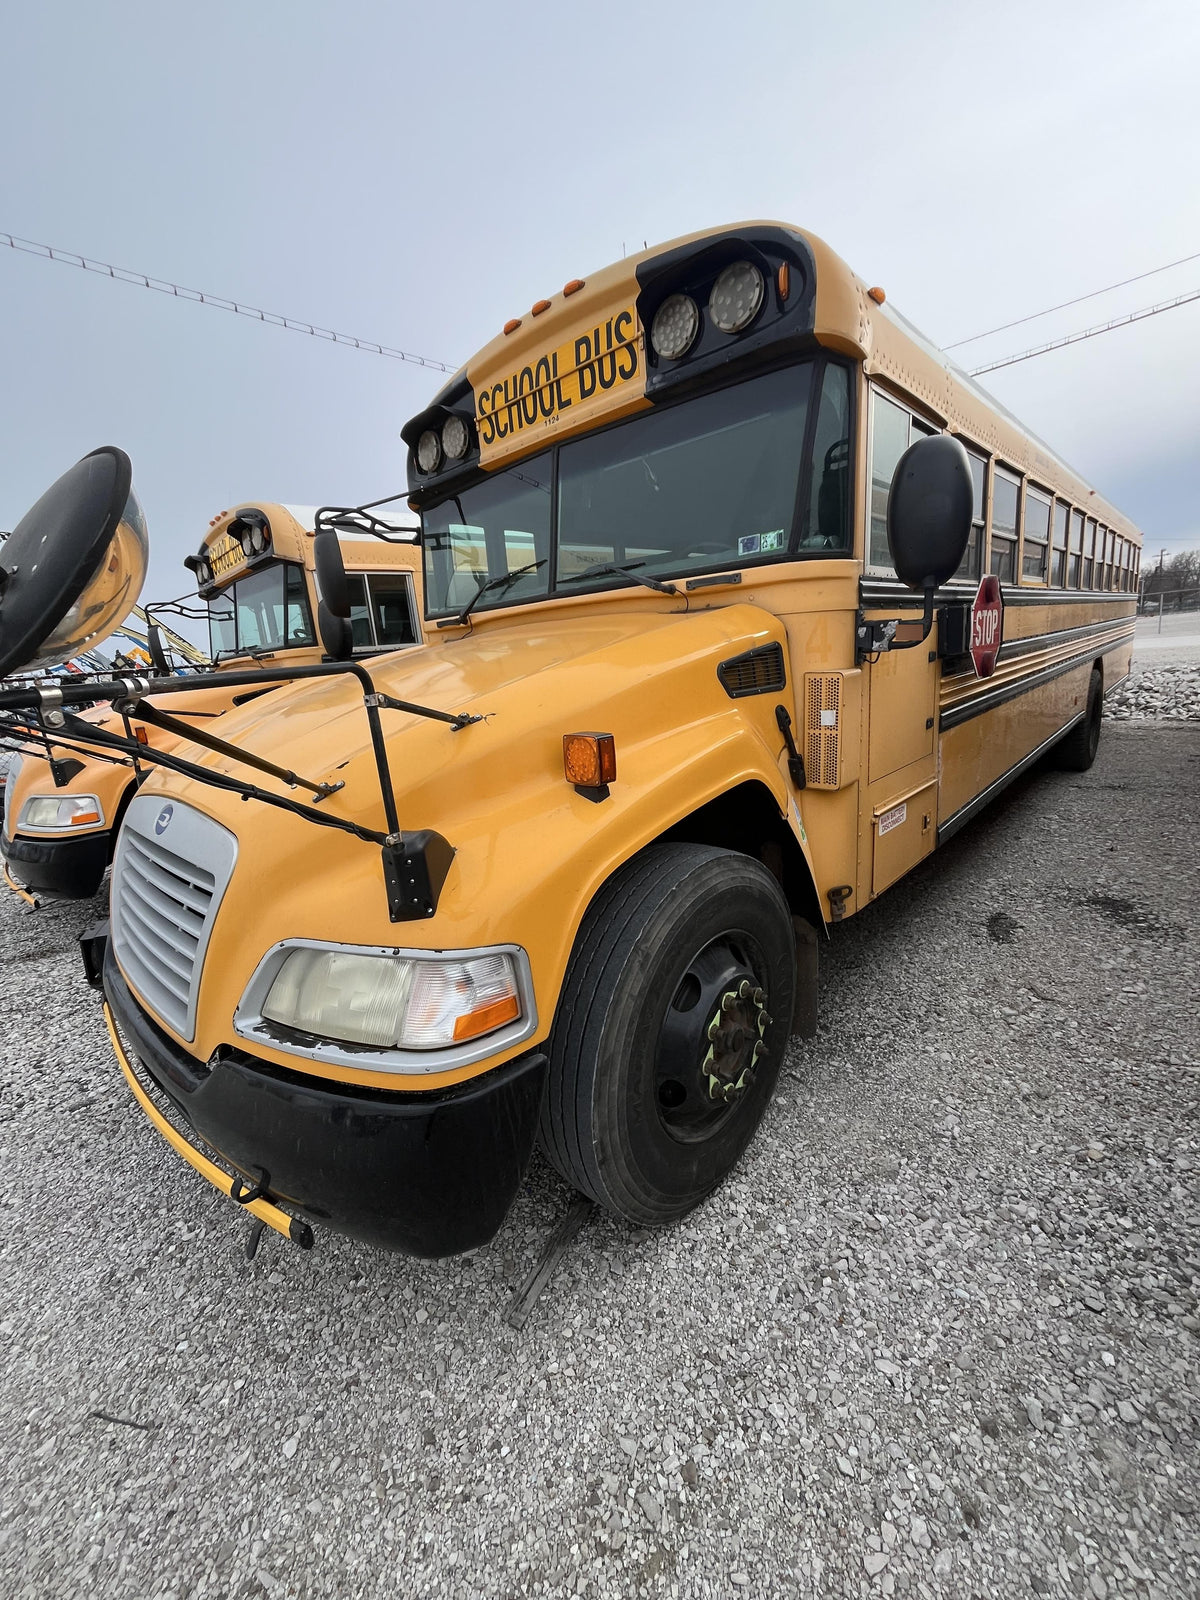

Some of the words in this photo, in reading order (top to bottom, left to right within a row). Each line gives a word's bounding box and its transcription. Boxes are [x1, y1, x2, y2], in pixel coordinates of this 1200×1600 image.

[478, 351, 572, 445] SCHOOL
[574, 310, 638, 400] BUS
[543, 415, 560, 427] 1124
[975, 608, 999, 647] STOP
